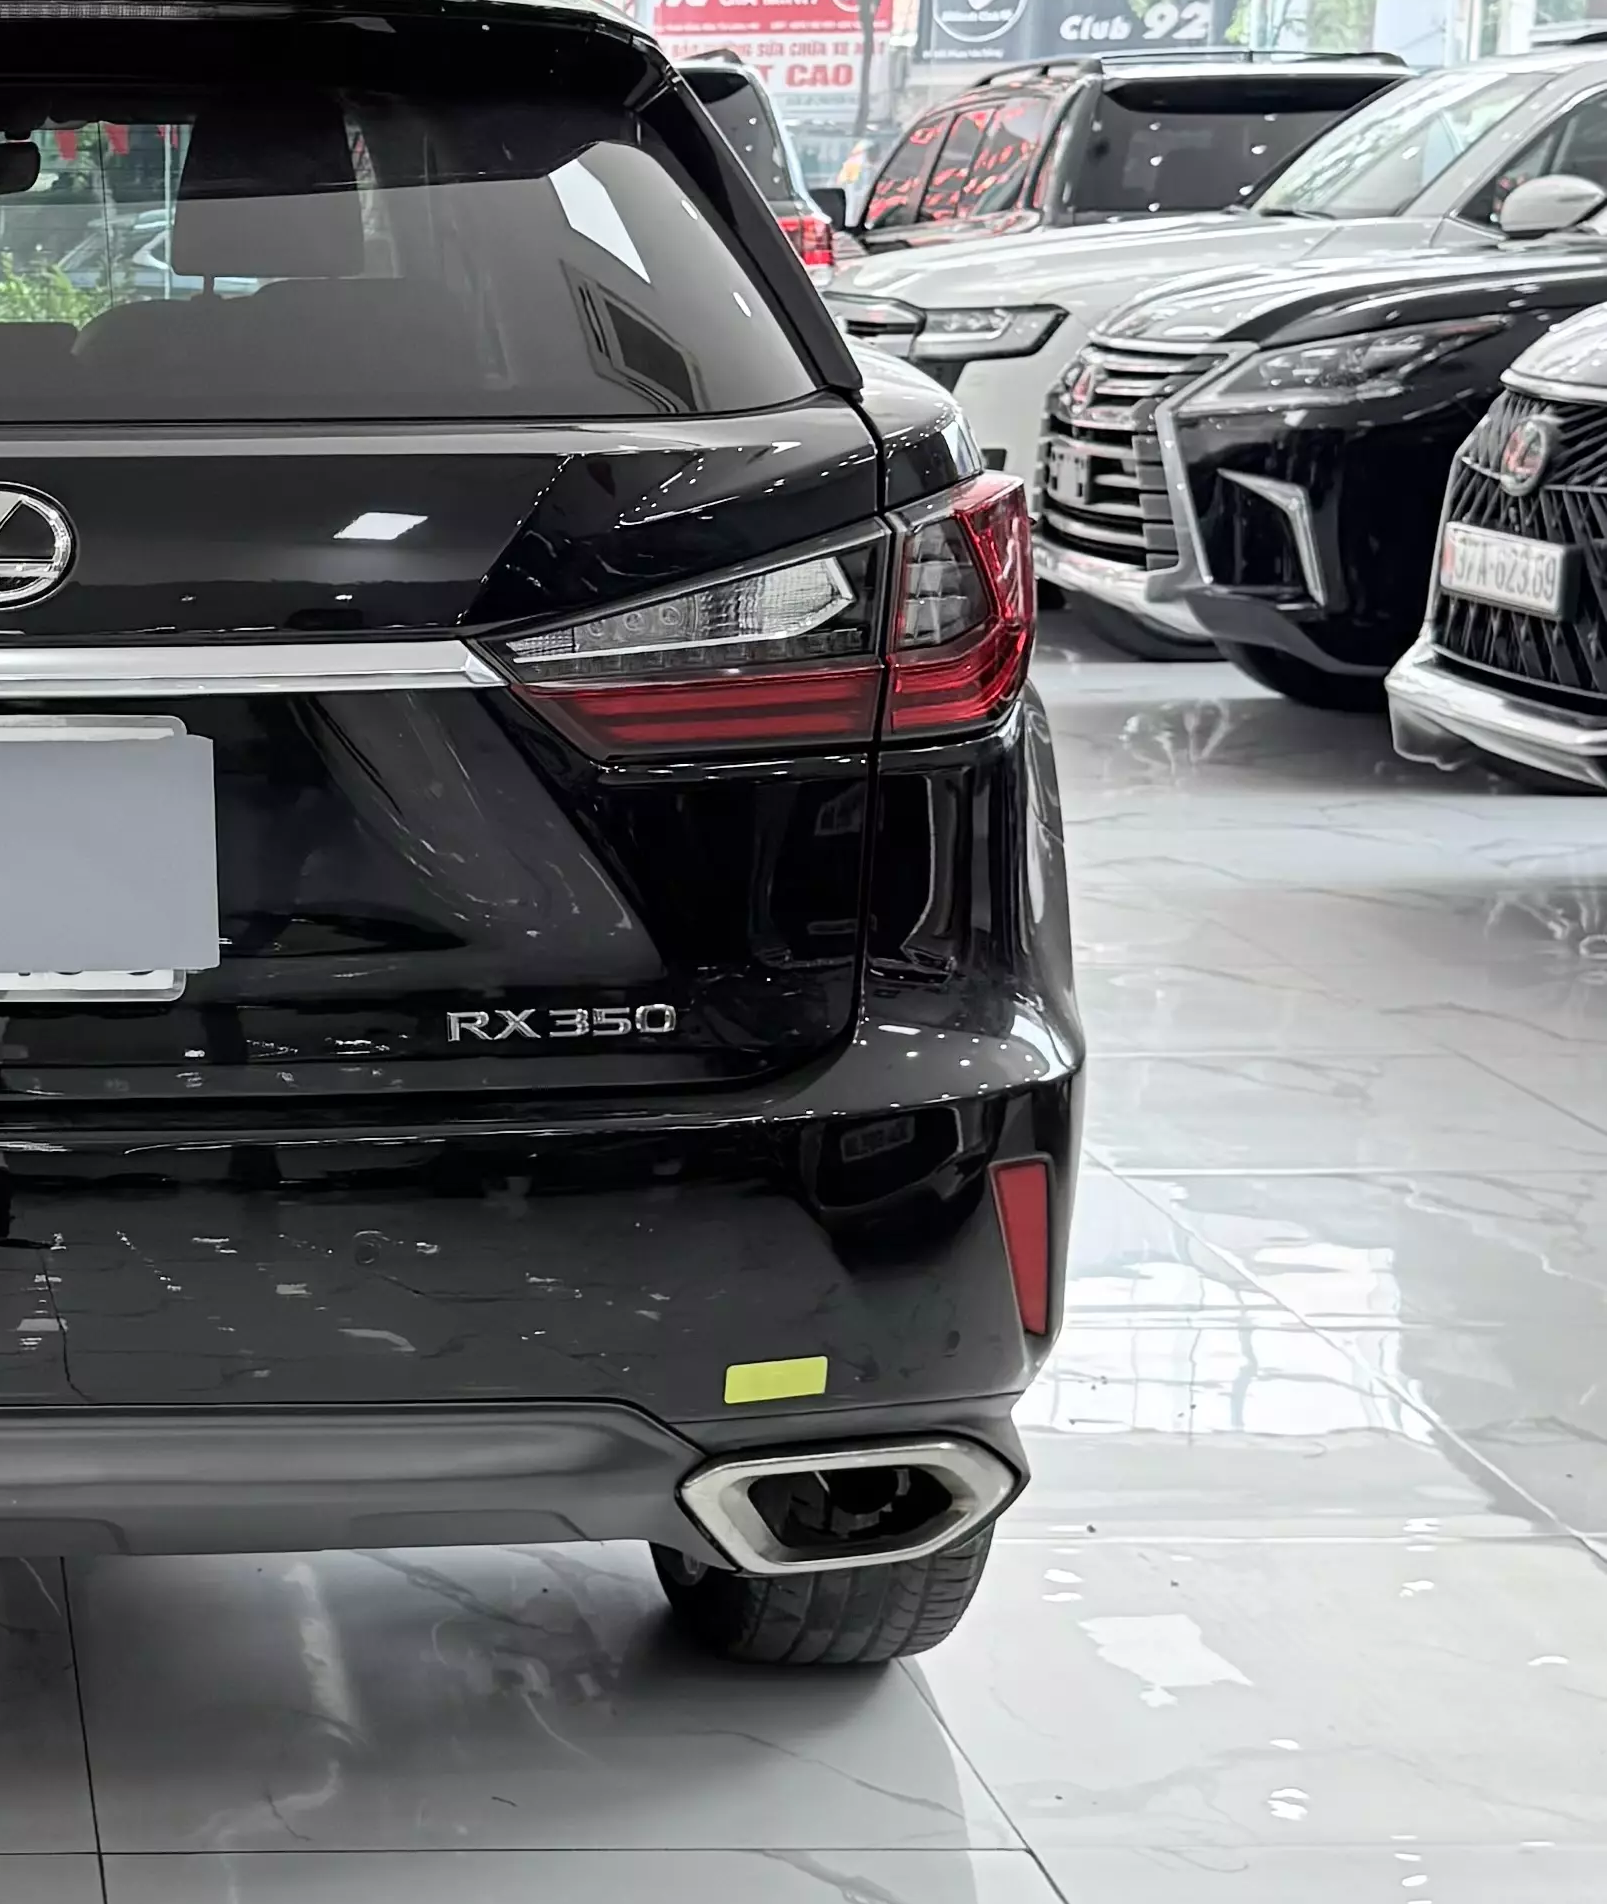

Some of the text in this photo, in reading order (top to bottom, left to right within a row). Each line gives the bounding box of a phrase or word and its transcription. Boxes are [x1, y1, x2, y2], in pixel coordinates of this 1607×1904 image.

[1060, 2, 1210, 41] Club 92
[785, 64, 854, 88] CAO
[447, 1003, 677, 1042] RX 350
